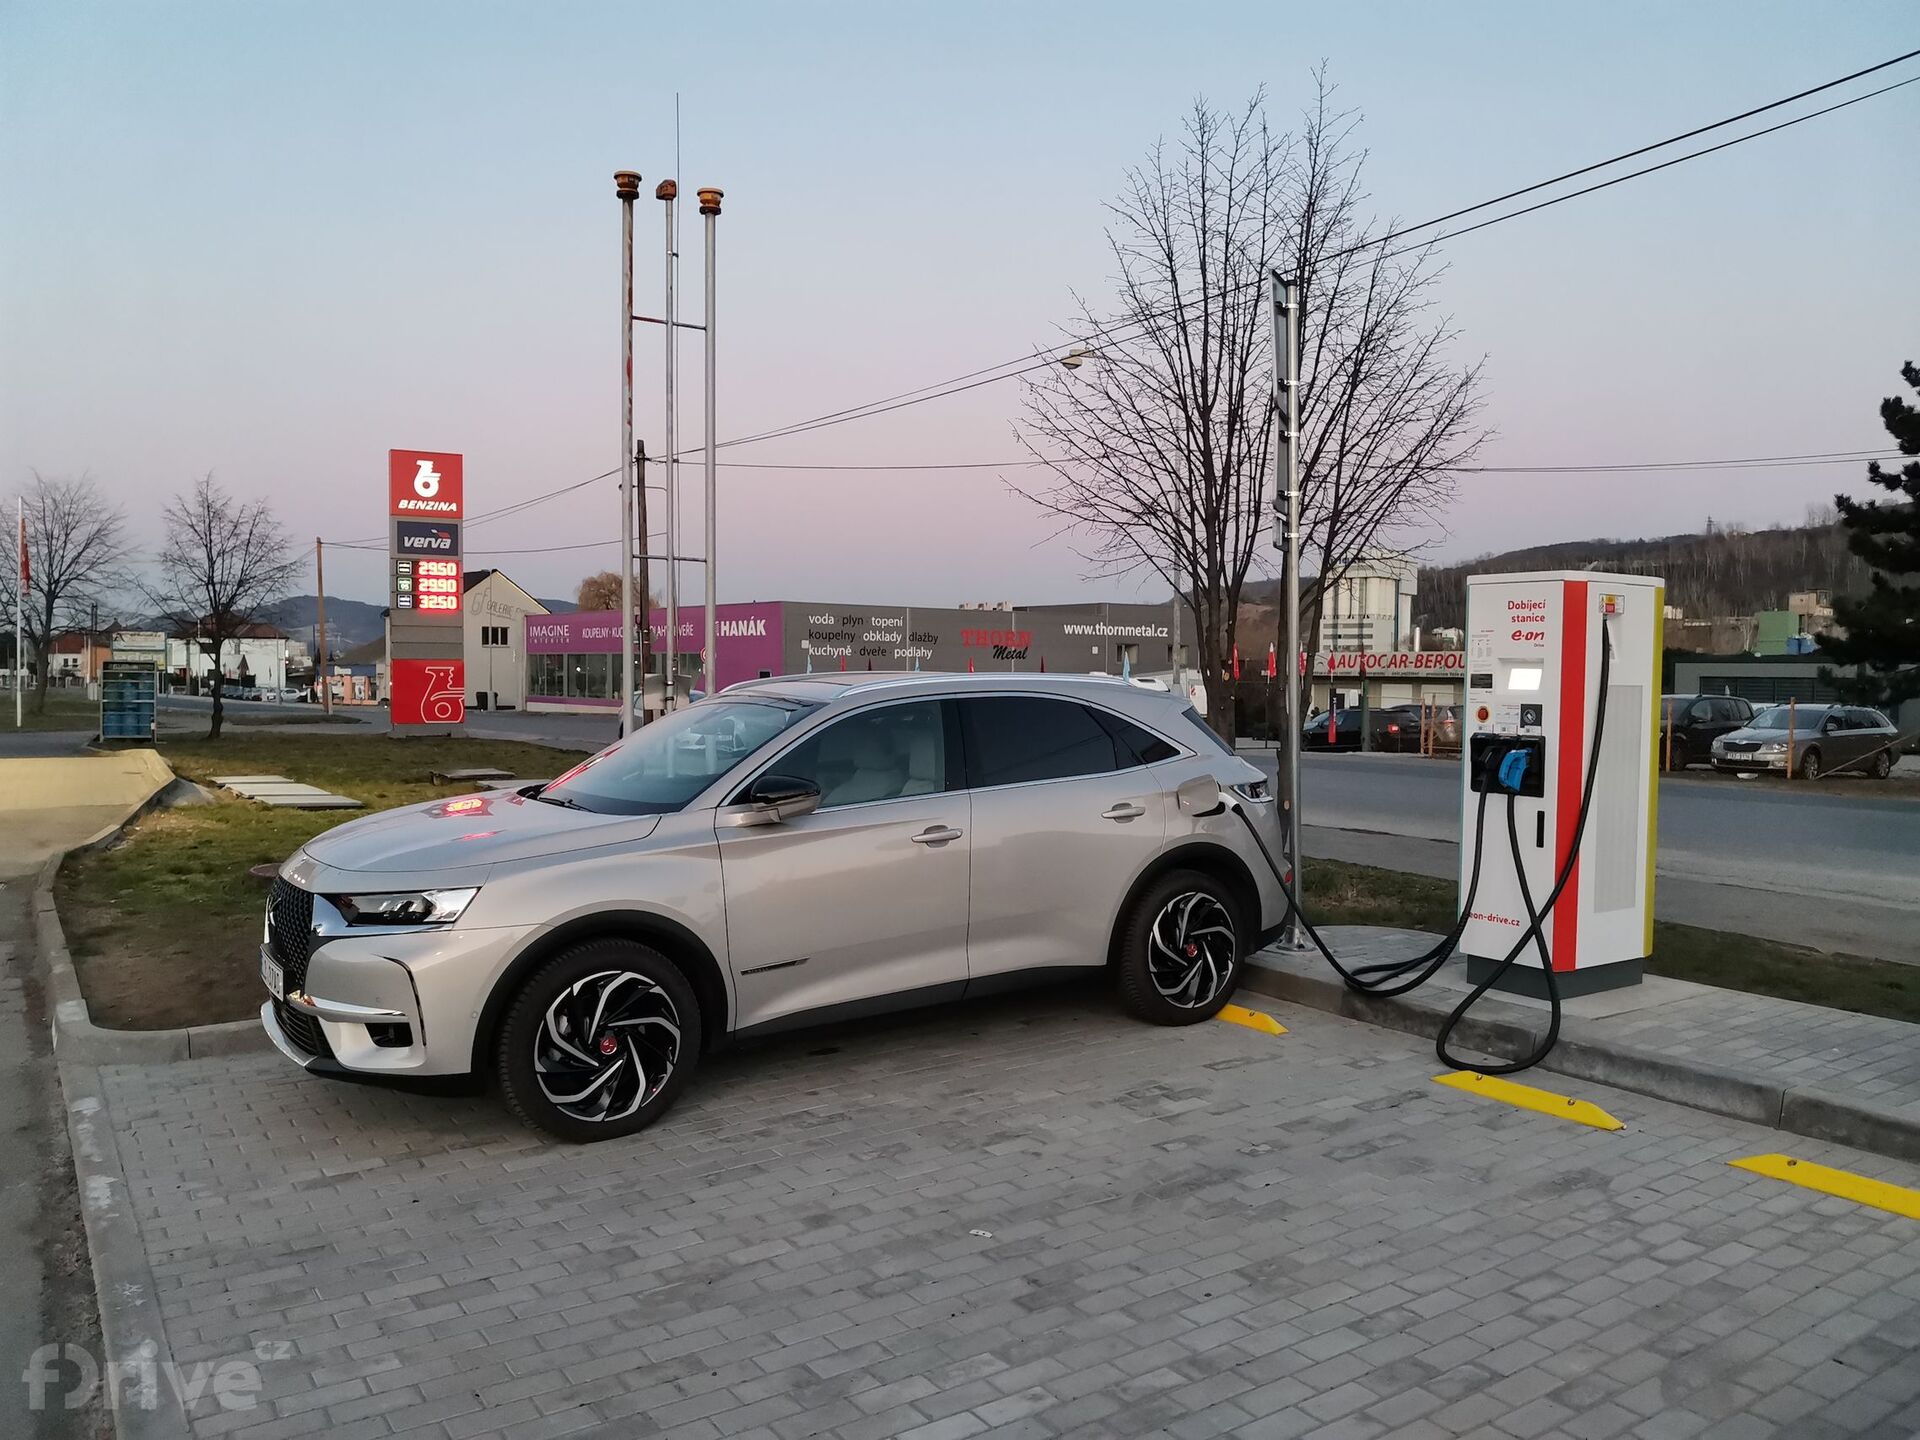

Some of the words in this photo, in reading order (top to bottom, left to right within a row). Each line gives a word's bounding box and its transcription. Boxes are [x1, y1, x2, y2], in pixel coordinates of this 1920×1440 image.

[398, 499, 457, 511] BENZINA
[403, 536, 451, 550] verva
[809, 613, 834, 625] voda
[842, 614, 864, 628] plyn
[871, 616, 903, 629] topení
[1511, 613, 1546, 623] stanice
[530, 625, 569, 637] IMAGINE
[582, 627, 609, 639] KOUPELNY
[721, 616, 766, 637] HANÁK
[1064, 622, 1168, 637] www.thornmetal.cz
[809, 629, 856, 643] koupelny
[863, 630, 902, 644] obklady
[908, 632, 939, 645] dlažby
[960, 629, 1032, 648] THORN
[809, 644, 852, 658] kuchyně
[859, 646, 887, 656] dveře
[894, 646, 933, 659] podlahy
[993, 645, 1029, 660] Metal
